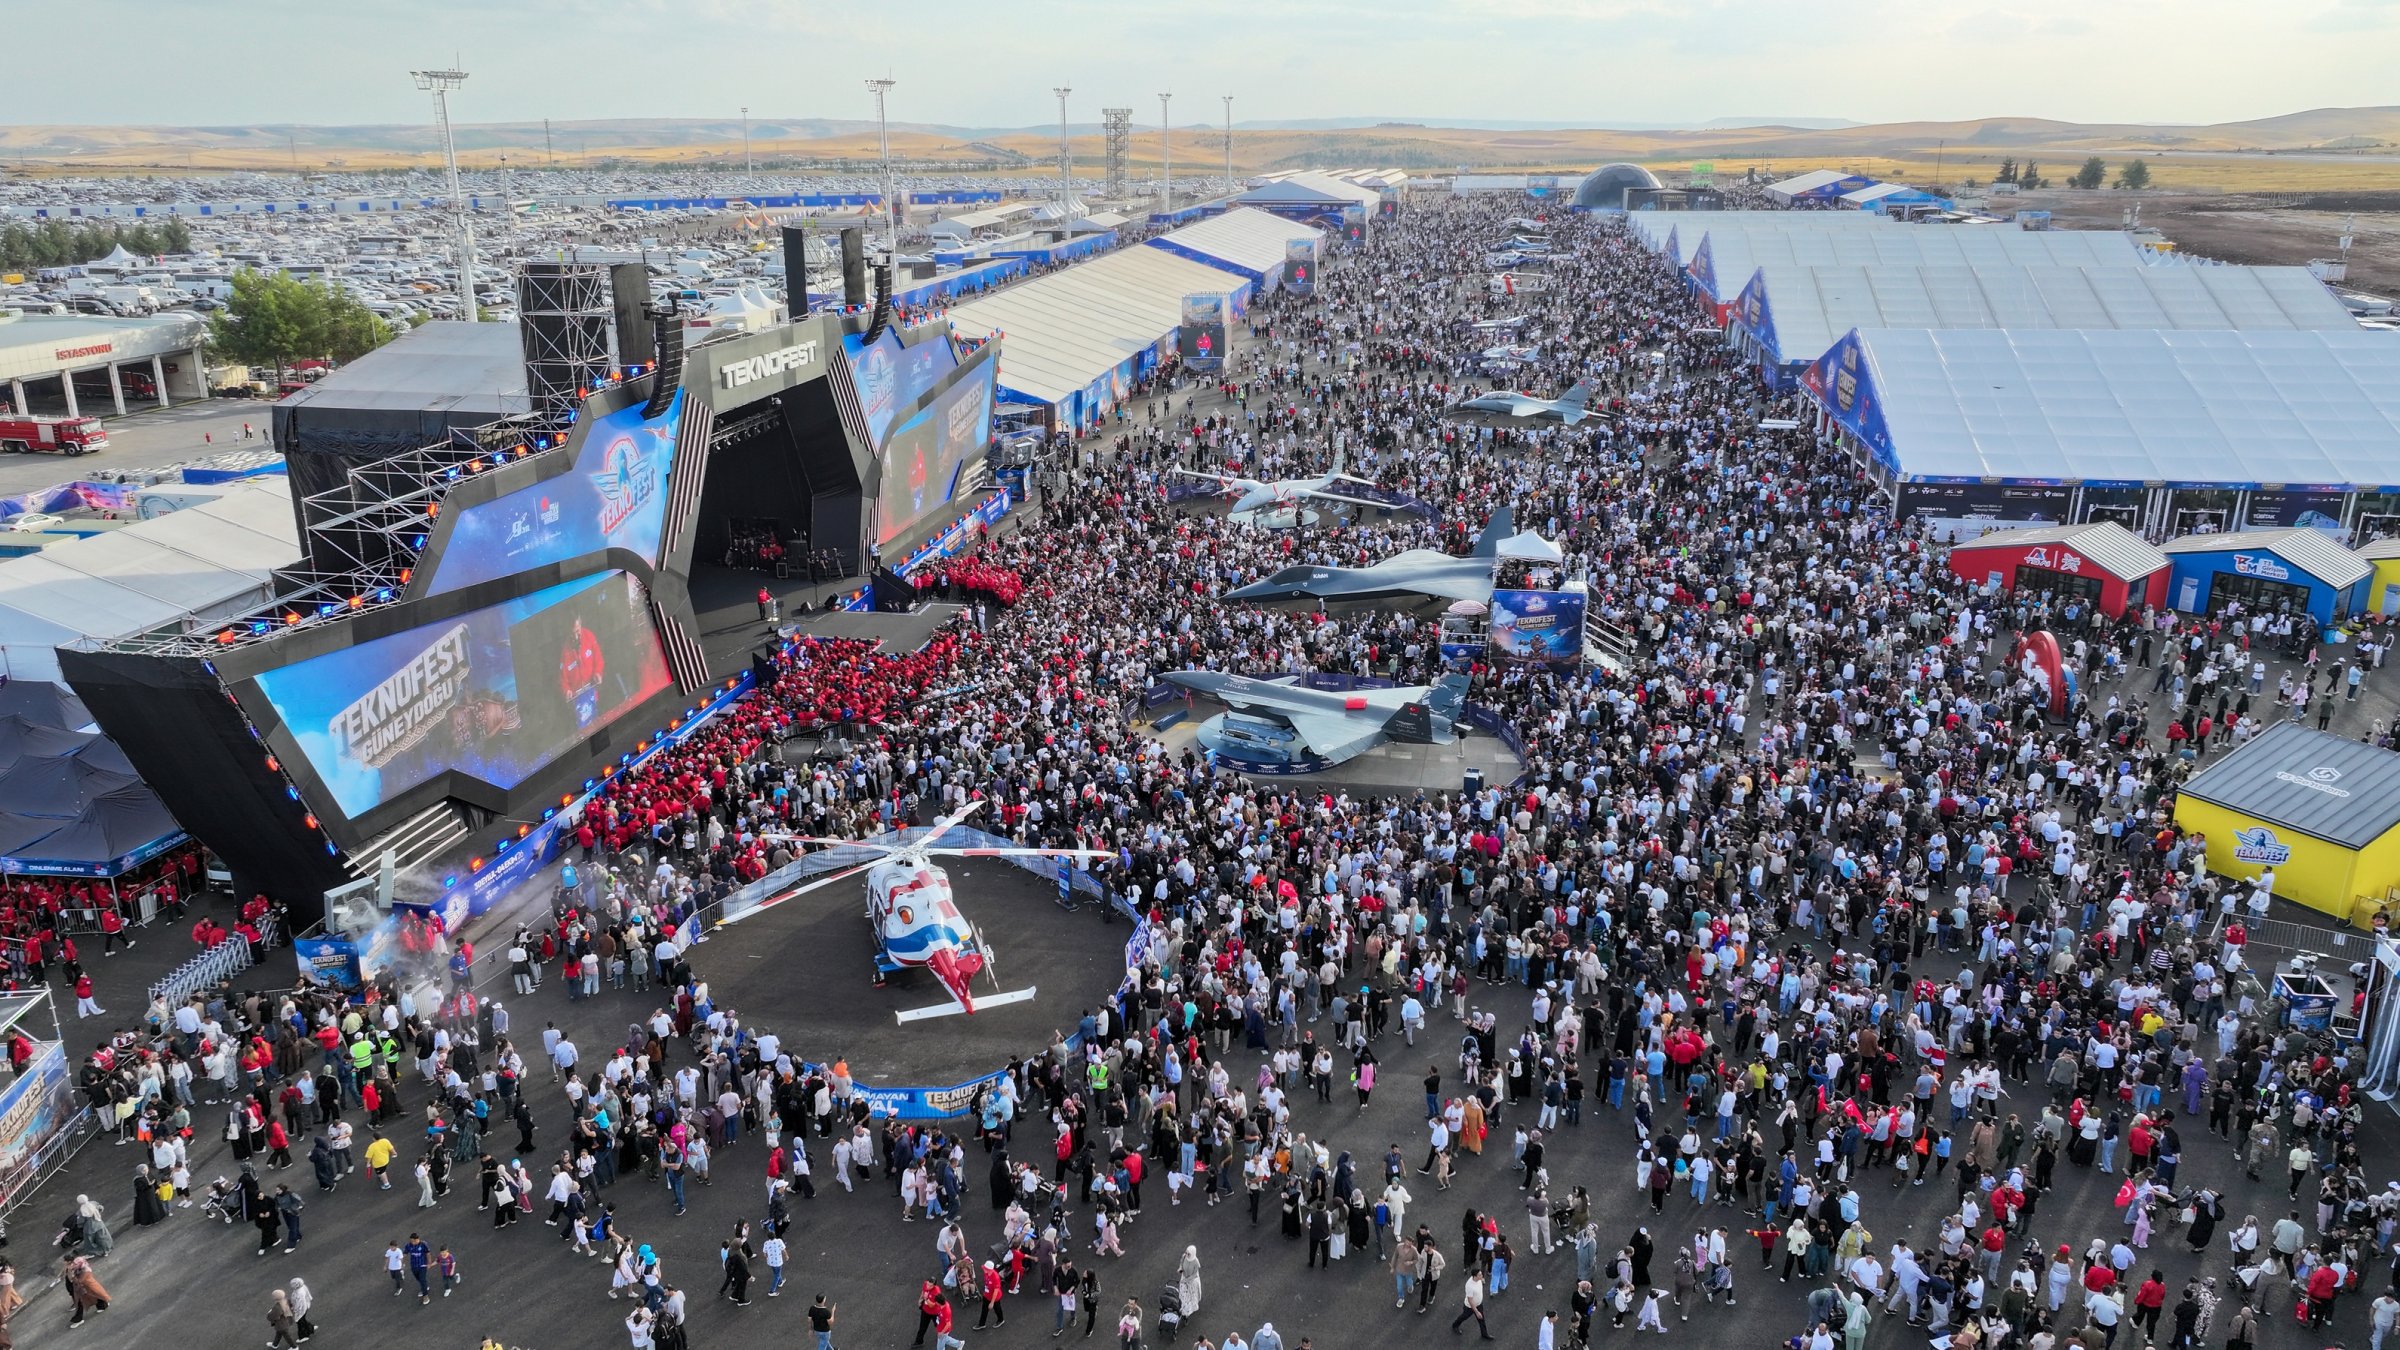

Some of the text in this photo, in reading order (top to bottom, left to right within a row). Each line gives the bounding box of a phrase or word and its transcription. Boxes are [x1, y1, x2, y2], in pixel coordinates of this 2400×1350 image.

[722, 340, 816, 389] TEKNOFEST
[600, 467, 655, 535] TEKNOFEST
[2261, 570, 2286, 579] Merkezi
[2262, 565, 2285, 573] Girişim
[1516, 615, 1556, 627] TEKNOFEST
[329, 622, 469, 754] TEKNOFEST
[360, 676, 454, 763] GÜNEYDOĞU
[2235, 846, 2289, 862] TEKNOFEST
[311, 955, 346, 964] TEKNOFEST
[0, 1071, 46, 1136] EKNOFEST
